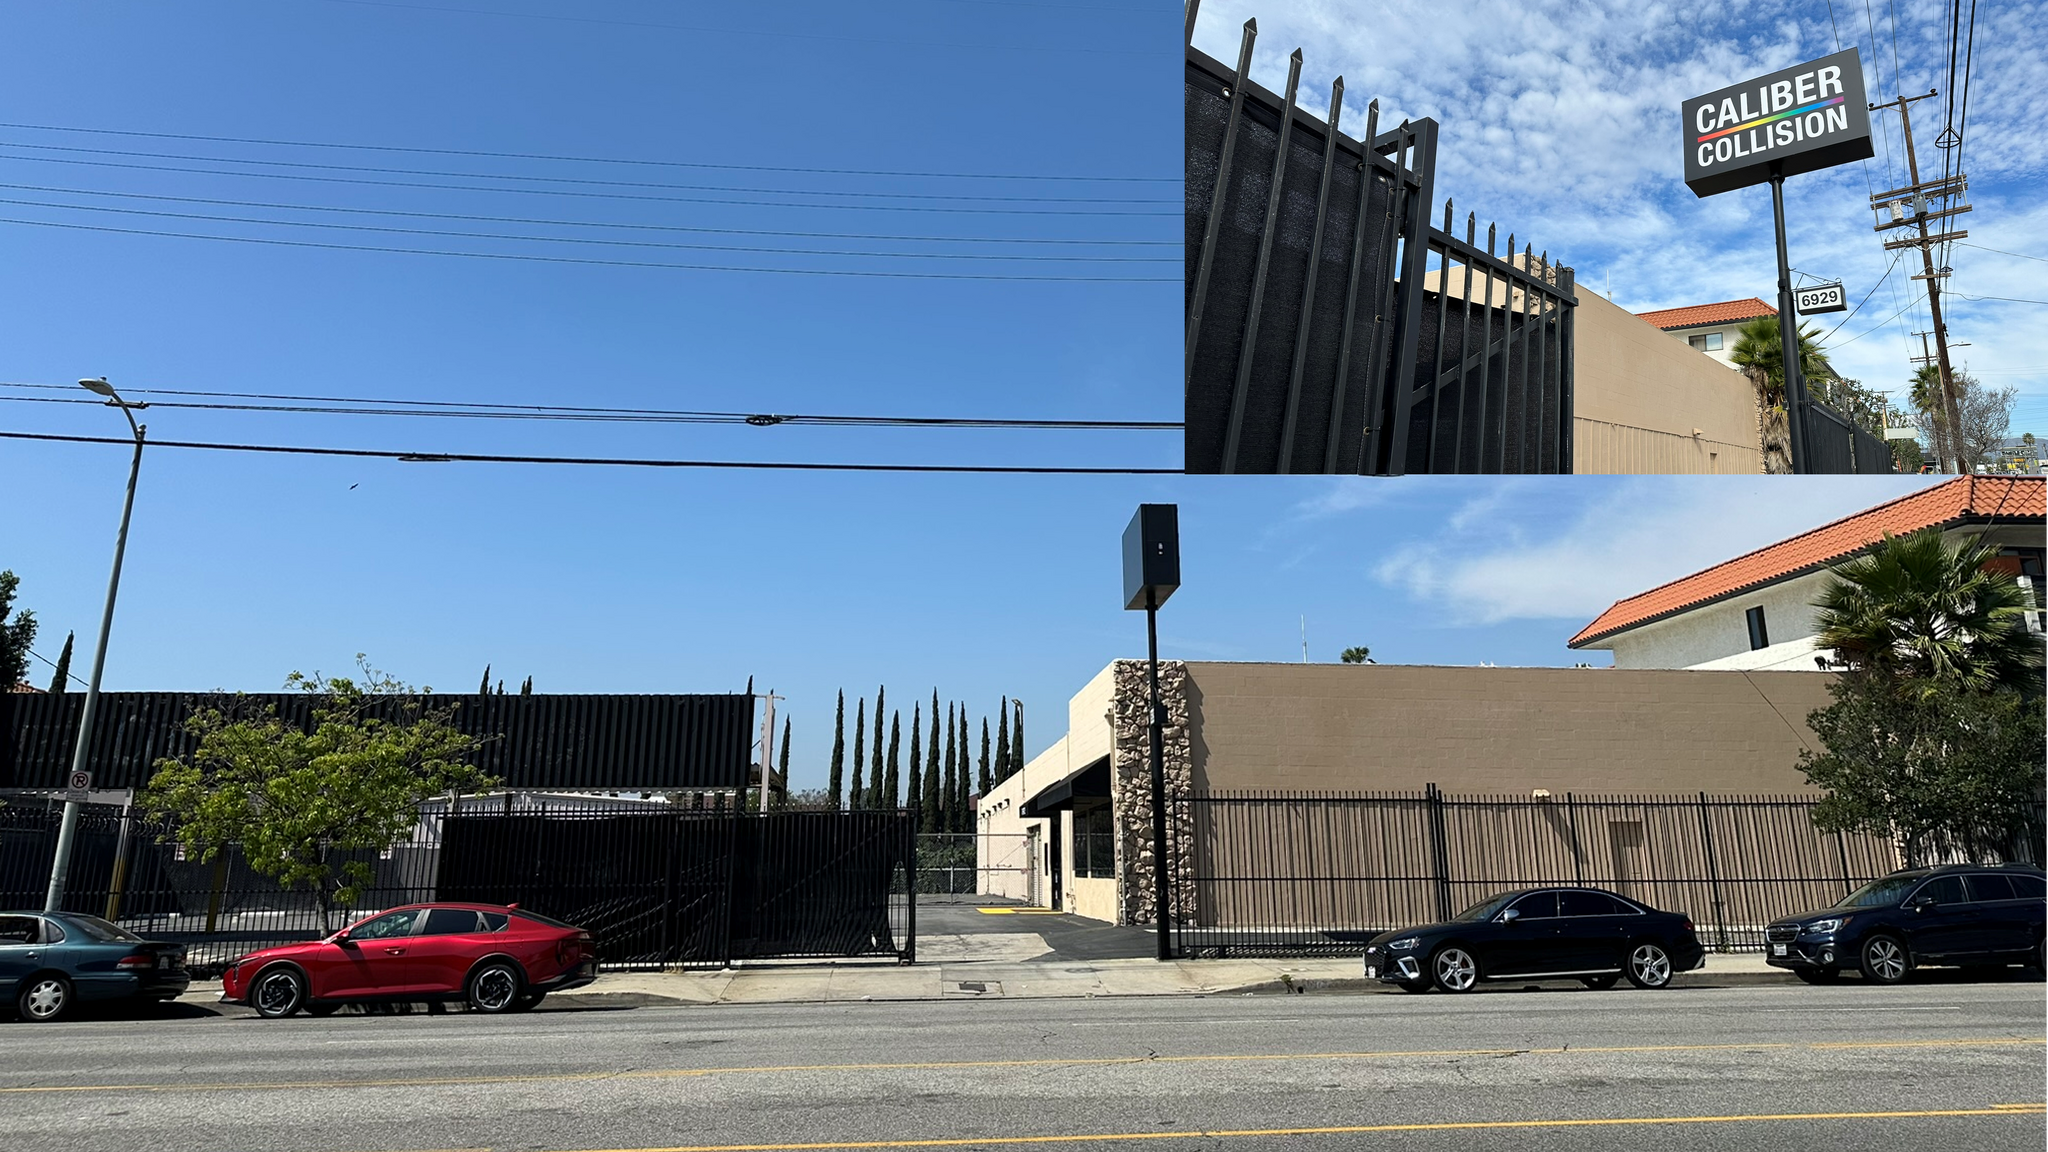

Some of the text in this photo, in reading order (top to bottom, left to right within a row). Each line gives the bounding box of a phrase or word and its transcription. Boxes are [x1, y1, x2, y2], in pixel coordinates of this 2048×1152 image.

[1696, 65, 1844, 133] CALIBER
[1697, 104, 1849, 168] COLLISION
[1801, 289, 1839, 307] 6929
